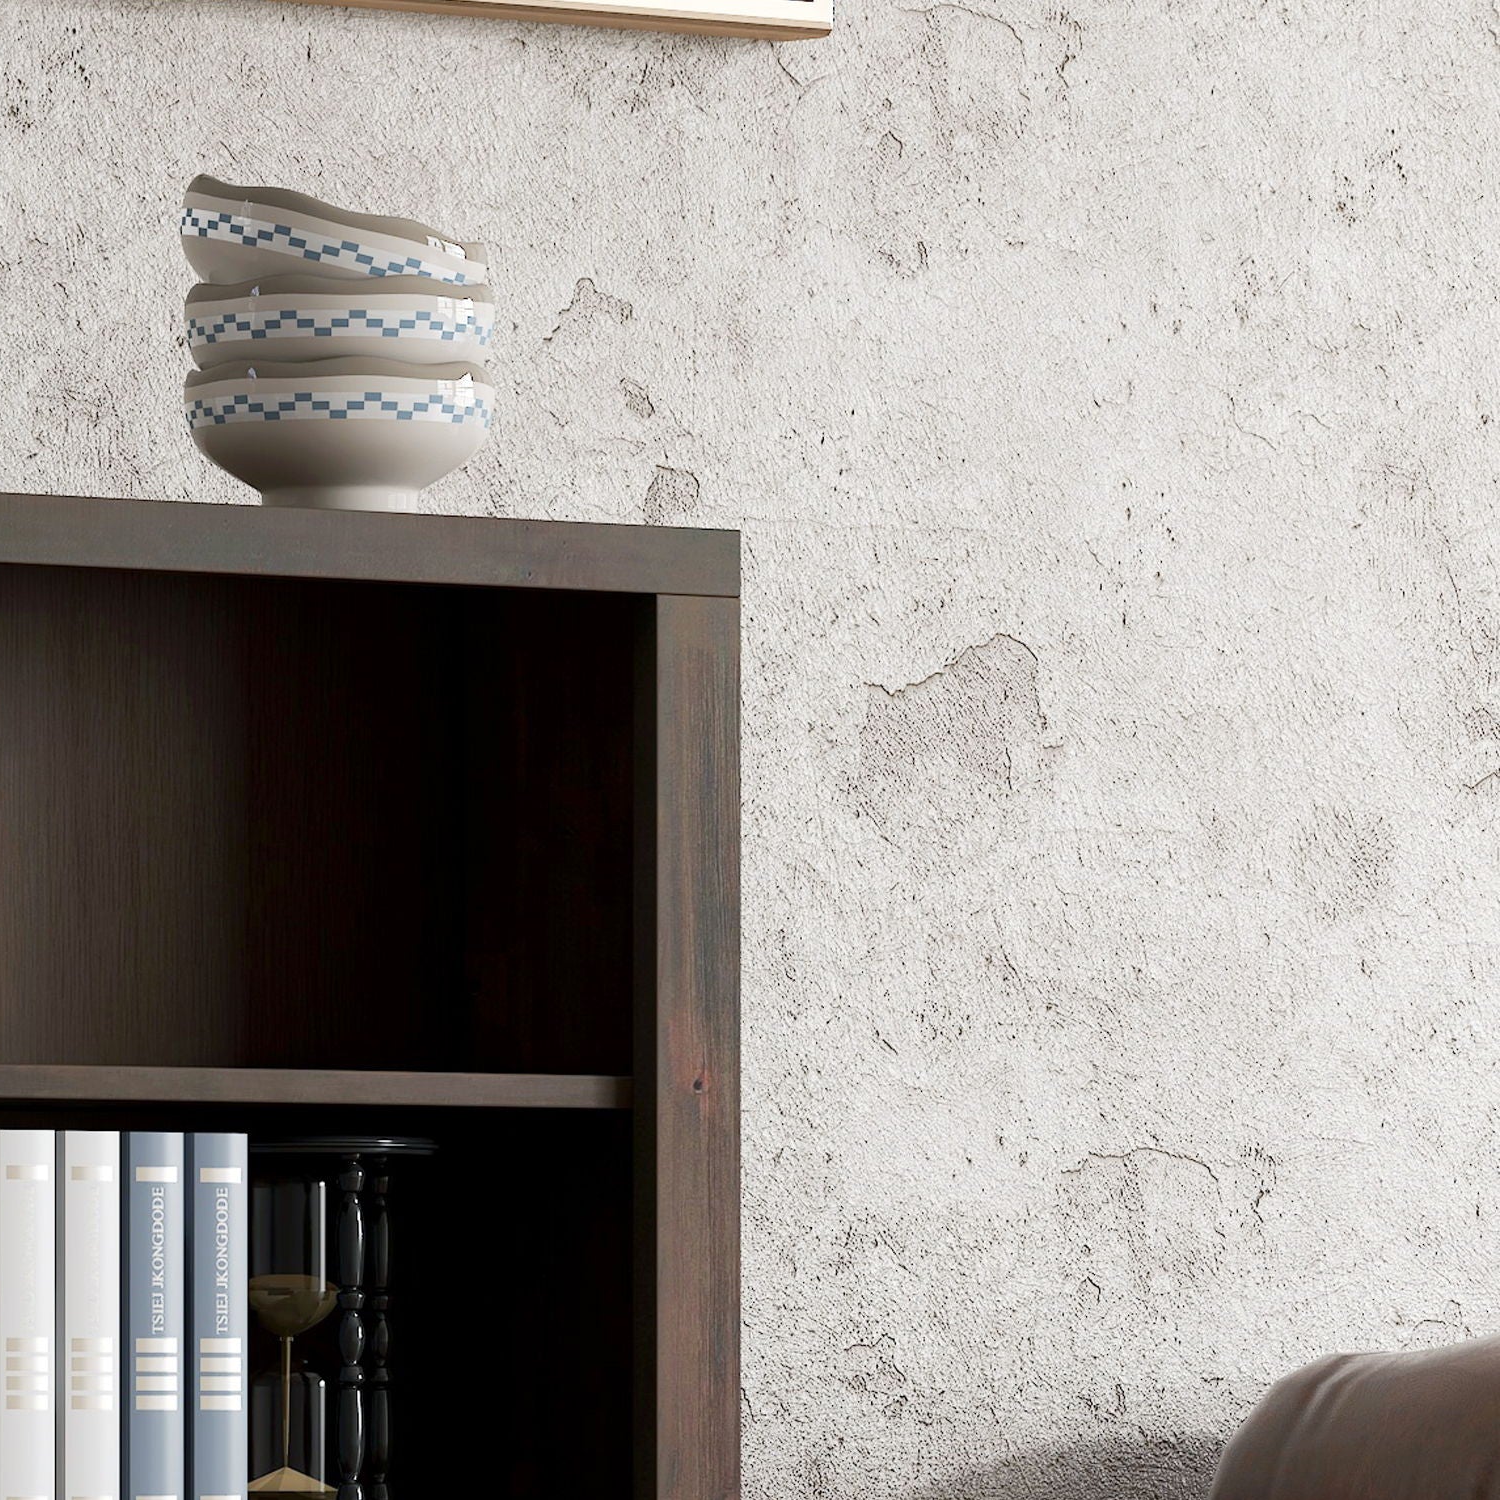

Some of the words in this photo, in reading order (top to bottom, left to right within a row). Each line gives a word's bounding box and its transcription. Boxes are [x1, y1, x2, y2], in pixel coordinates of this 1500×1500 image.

[152, 1186, 165, 1289] JKONGDODE
[216, 1187, 229, 1289] JKONGDODE
[152, 1293, 165, 1335] TSIEJ
[216, 1293, 229, 1335] TSIEJ
